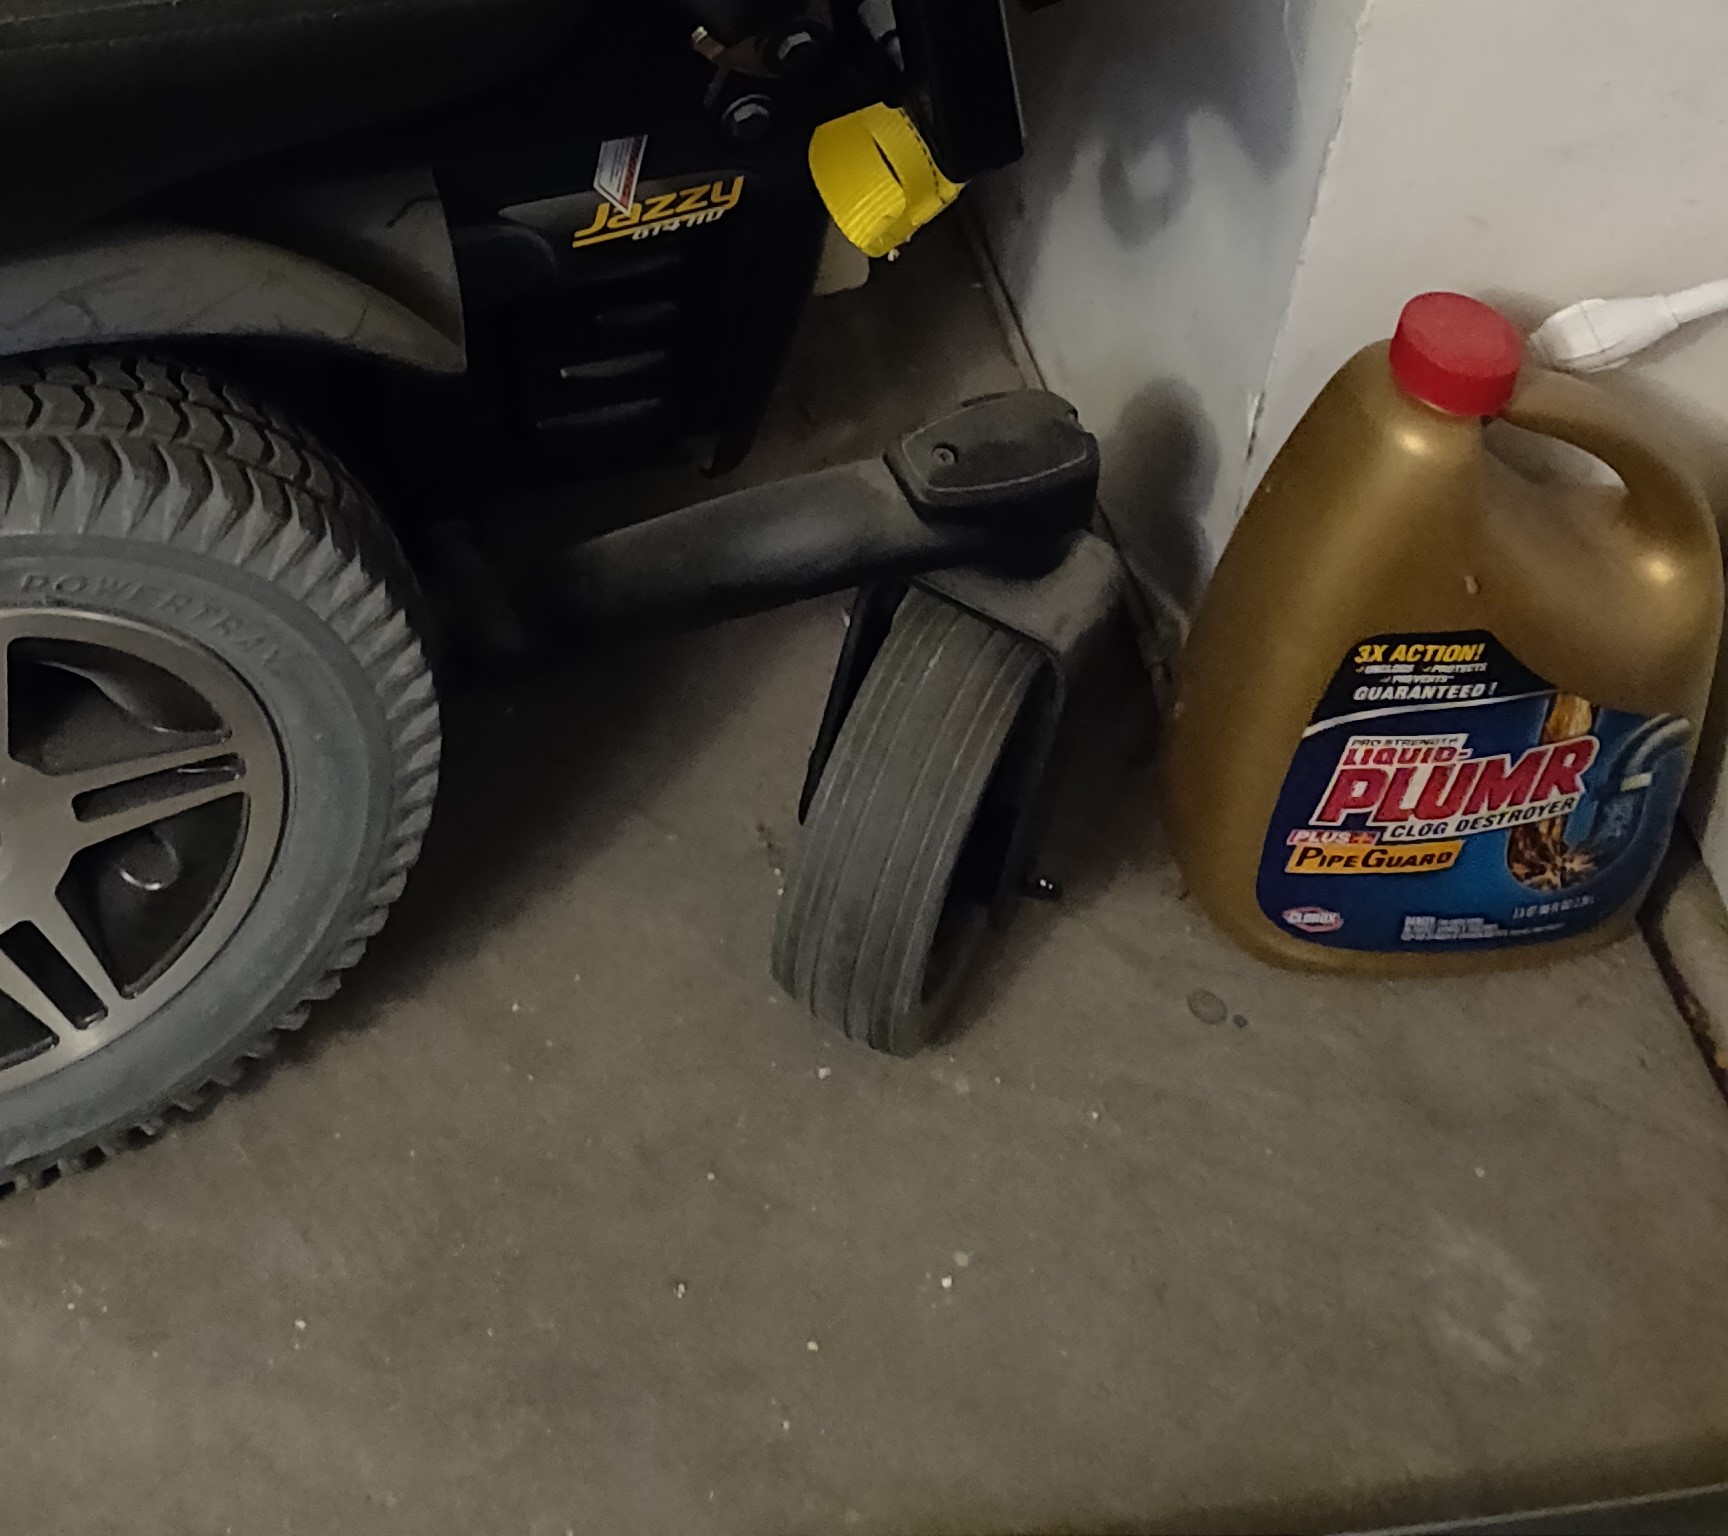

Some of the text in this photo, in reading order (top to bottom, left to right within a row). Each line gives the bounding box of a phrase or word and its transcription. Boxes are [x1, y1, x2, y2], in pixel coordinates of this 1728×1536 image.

[575, 175, 744, 237] Jazzy
[1354, 643, 1485, 663] 3X ACTION!
[1316, 739, 1595, 824] PLUMR
[1390, 798, 1575, 839] CLOG DESTROYER
